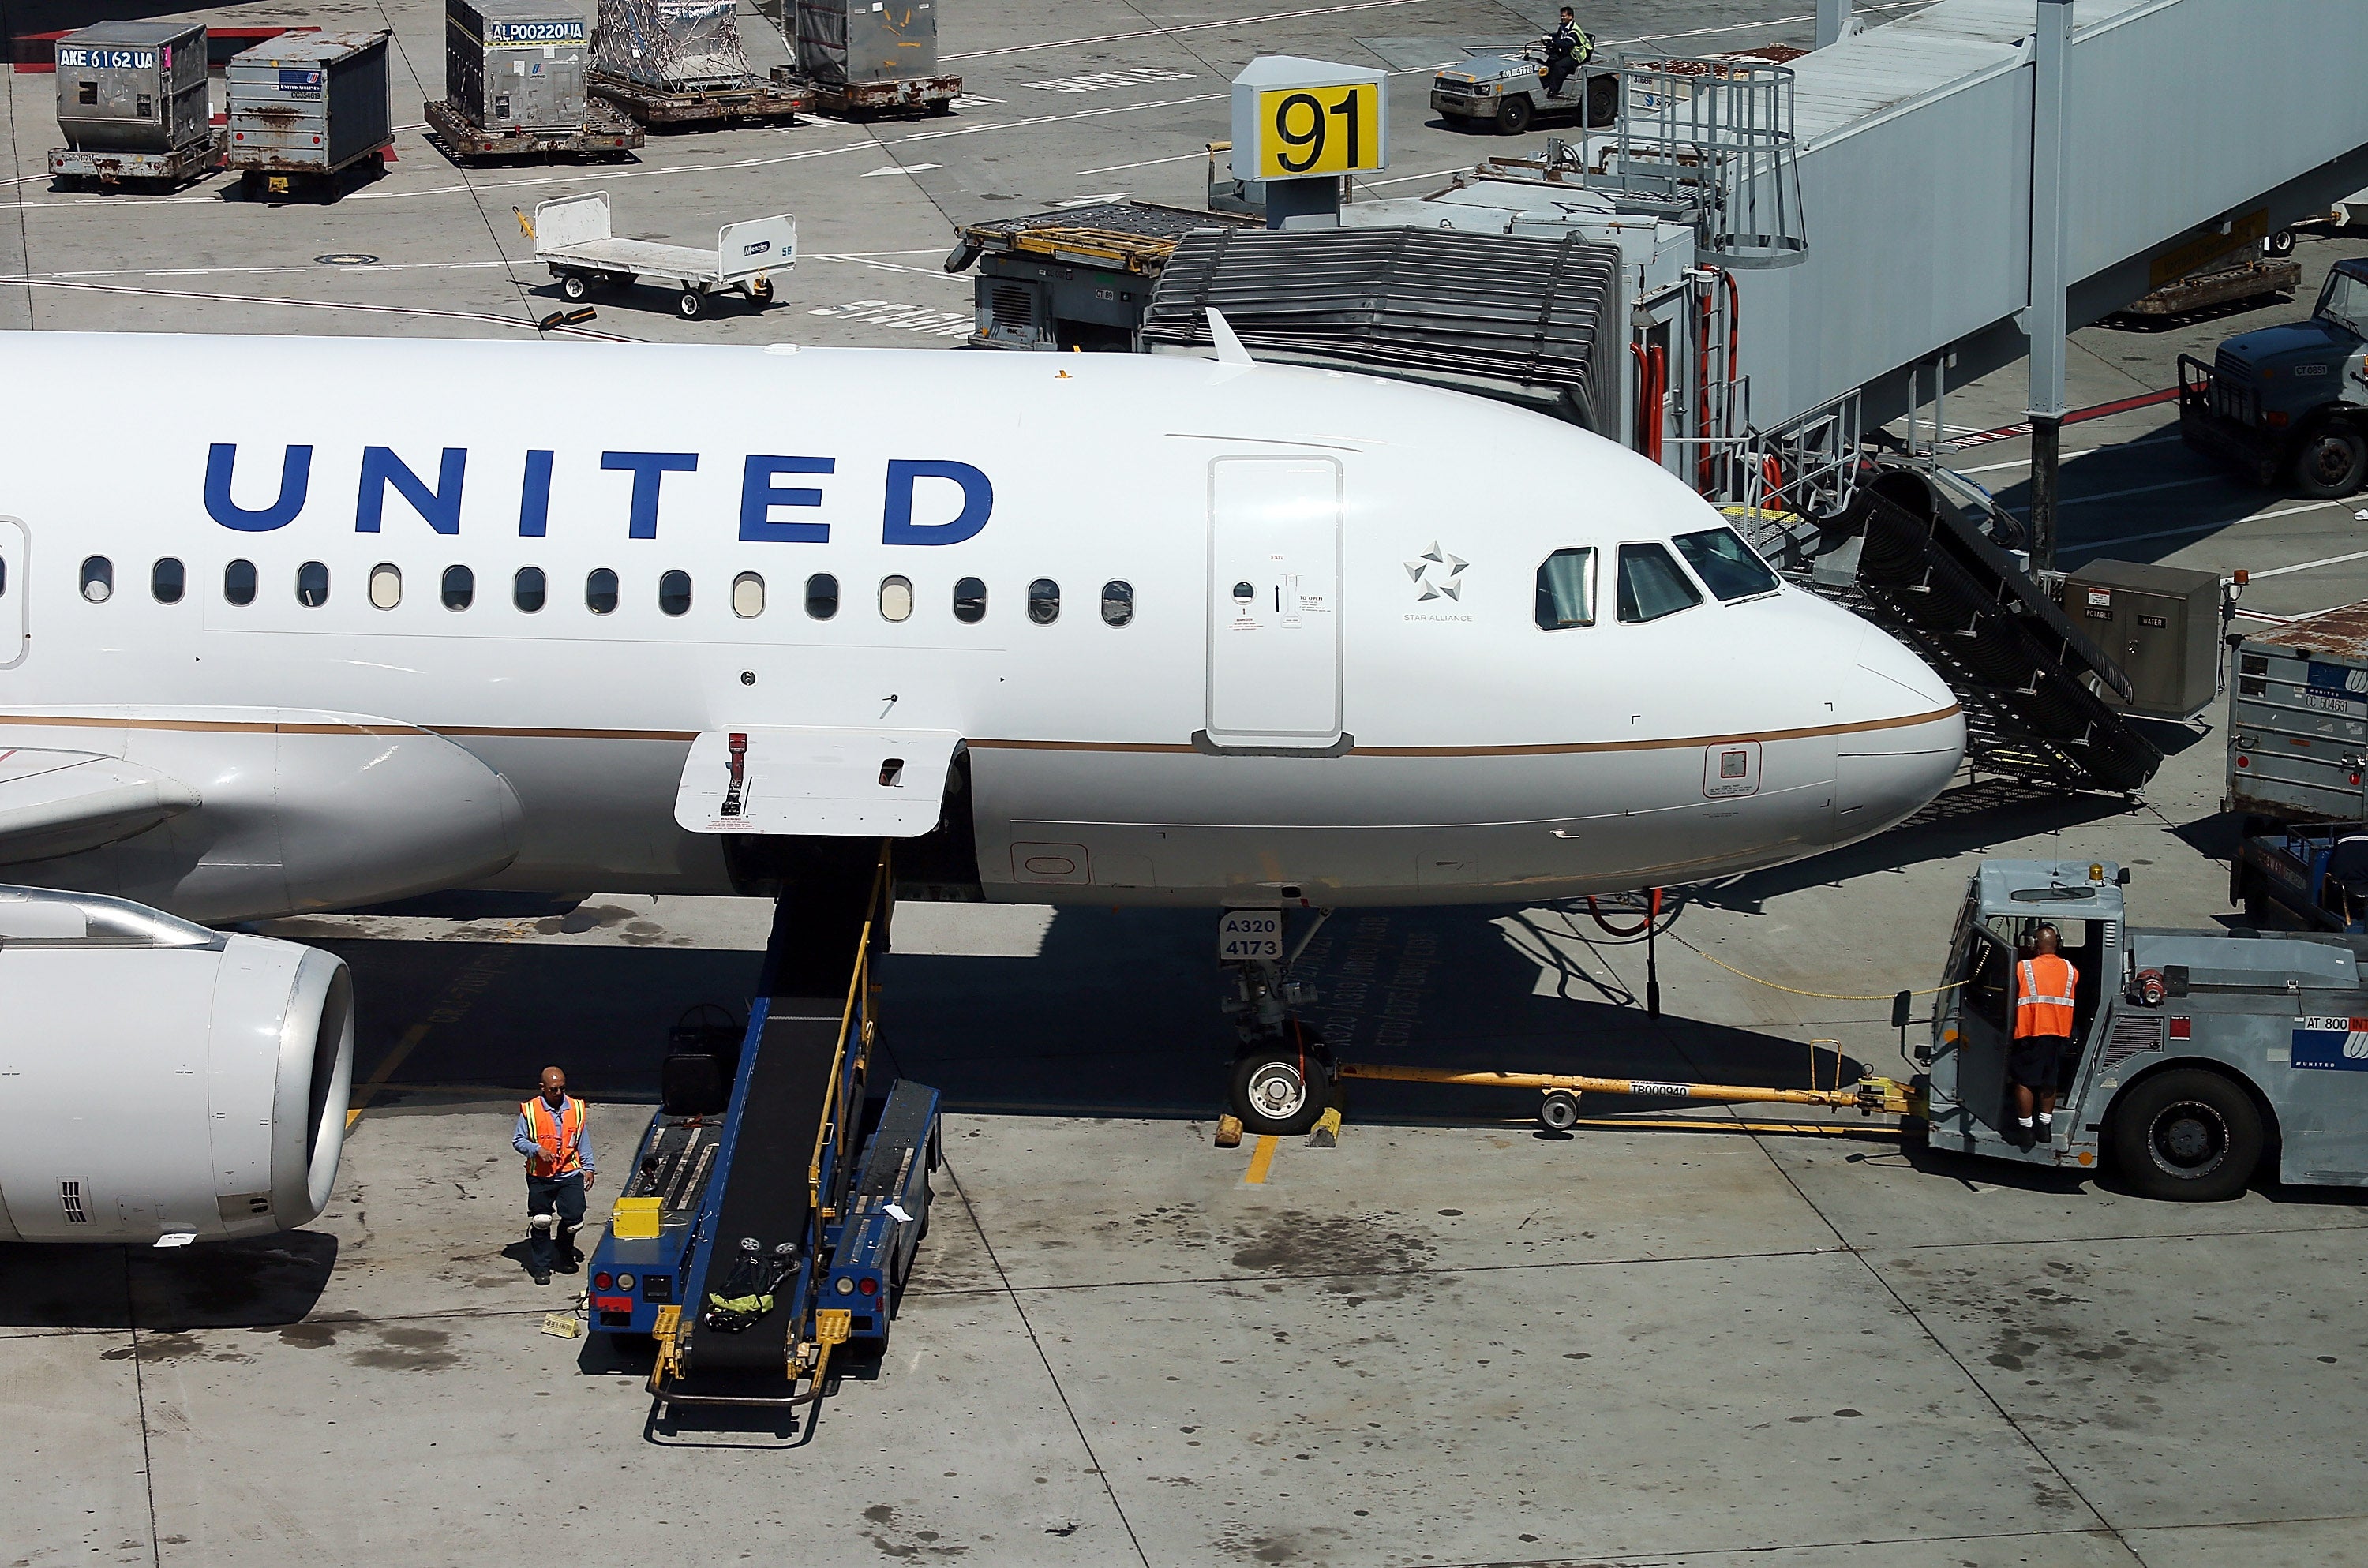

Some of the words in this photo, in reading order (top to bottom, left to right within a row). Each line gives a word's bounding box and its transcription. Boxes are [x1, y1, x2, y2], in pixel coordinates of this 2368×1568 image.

[493, 24, 583, 41] ALP00220UA
[60, 50, 87, 66] AKE
[91, 51, 132, 68] 6162
[134, 52, 152, 69] UA
[1276, 89, 1359, 173] 91
[744, 243, 768, 256] Menzies
[204, 443, 993, 546] UNITED
[2086, 609, 2111, 620] POTABLE
[2142, 618, 2162, 627] WATER
[2306, 695, 2316, 707] CC
[2319, 698, 2348, 713] 504631
[1226, 920, 1275, 933] A320
[1226, 941, 1276, 956] 4173
[2306, 1017, 2321, 1029] AT
[2325, 1018, 2347, 1030] 800
[1632, 1084, 1687, 1097] TB000940
